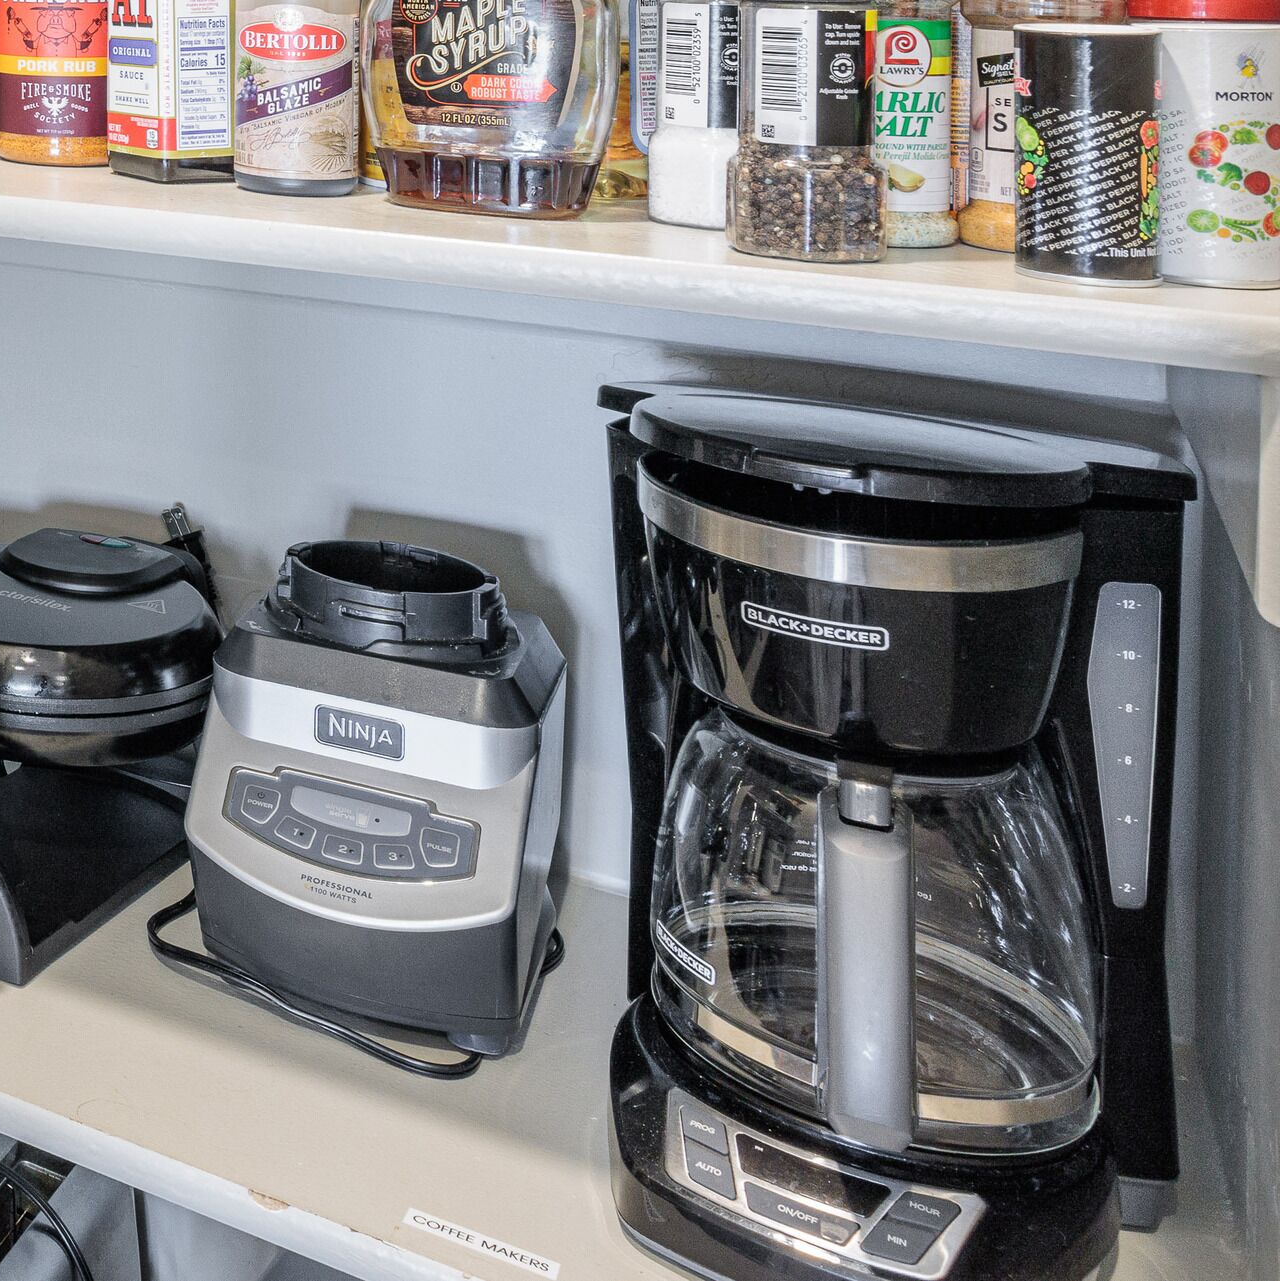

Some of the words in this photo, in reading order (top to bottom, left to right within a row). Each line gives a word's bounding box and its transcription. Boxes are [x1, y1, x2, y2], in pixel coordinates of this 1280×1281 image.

[244, 30, 338, 50] BERTOLLI
[432, 16, 529, 75] SYRUP
[692, 28, 702, 57] 02359
[112, 46, 152, 58] ORIGINAL
[215, 53, 226, 66] 15
[17, 58, 58, 73] PORK
[63, 59, 97, 73] RUB
[497, 62, 529, 74] GRADE
[692, 59, 701, 87] 52100
[880, 65, 924, 75] LAWRY'S
[119, 70, 144, 80] SAUCE
[480, 77, 507, 89] DARK
[257, 77, 322, 106] BALSAMIC
[471, 87, 508, 99] ROBUST
[510, 89, 540, 100] TASTE
[1215, 91, 1272, 102] MORTON
[267, 93, 310, 114] GLAZE
[33, 111, 76, 124] SOCIETY
[441, 113, 451, 122] 12
[452, 114, 463, 123] FL
[465, 114, 476, 124] OZ
[1076, 122, 1115, 139] PEPPER
[906, 143, 925, 151] WITH
[1062, 150, 1100, 166] PEPPER
[1105, 138, 1136, 153] BLACK
[1075, 137, 1106, 152] BLACK
[1061, 163, 1094, 179] BLACK
[1093, 151, 1130, 169] PEPPER
[1047, 178, 1085, 193] PEPPER
[1089, 166, 1122, 181] BLACK
[1045, 191, 1077, 206] BLACK
[1076, 180, 1115, 197] PEPPER
[1074, 194, 1108, 209] BLACK
[1063, 208, 1100, 223] PEPPER
[1108, 247, 1130, 258] This
[1131, 247, 1146, 258] Unit
[747, 607, 882, 645] BLACK+DECKER
[328, 712, 393, 748] NINJA
[247, 797, 273, 810] POWER
[293, 827, 299, 836] 1
[338, 845, 347, 853] 2
[426, 842, 452, 854] PULSE
[388, 852, 398, 861] 3
[300, 873, 373, 900] PROFESSIONAL
[310, 885, 328, 896] 1100
[329, 891, 357, 904] WATTS
[656, 924, 711, 980] BLACK+DECKER
[690, 1119, 715, 1135] PROG
[695, 1161, 723, 1177] AUTO
[777, 1203, 819, 1225] ON/OFF
[908, 1199, 942, 1217] HOUR
[412, 1215, 476, 1244] COFFEE
[481, 1240, 550, 1272] MAKERS
[887, 1234, 907, 1248] MIN
